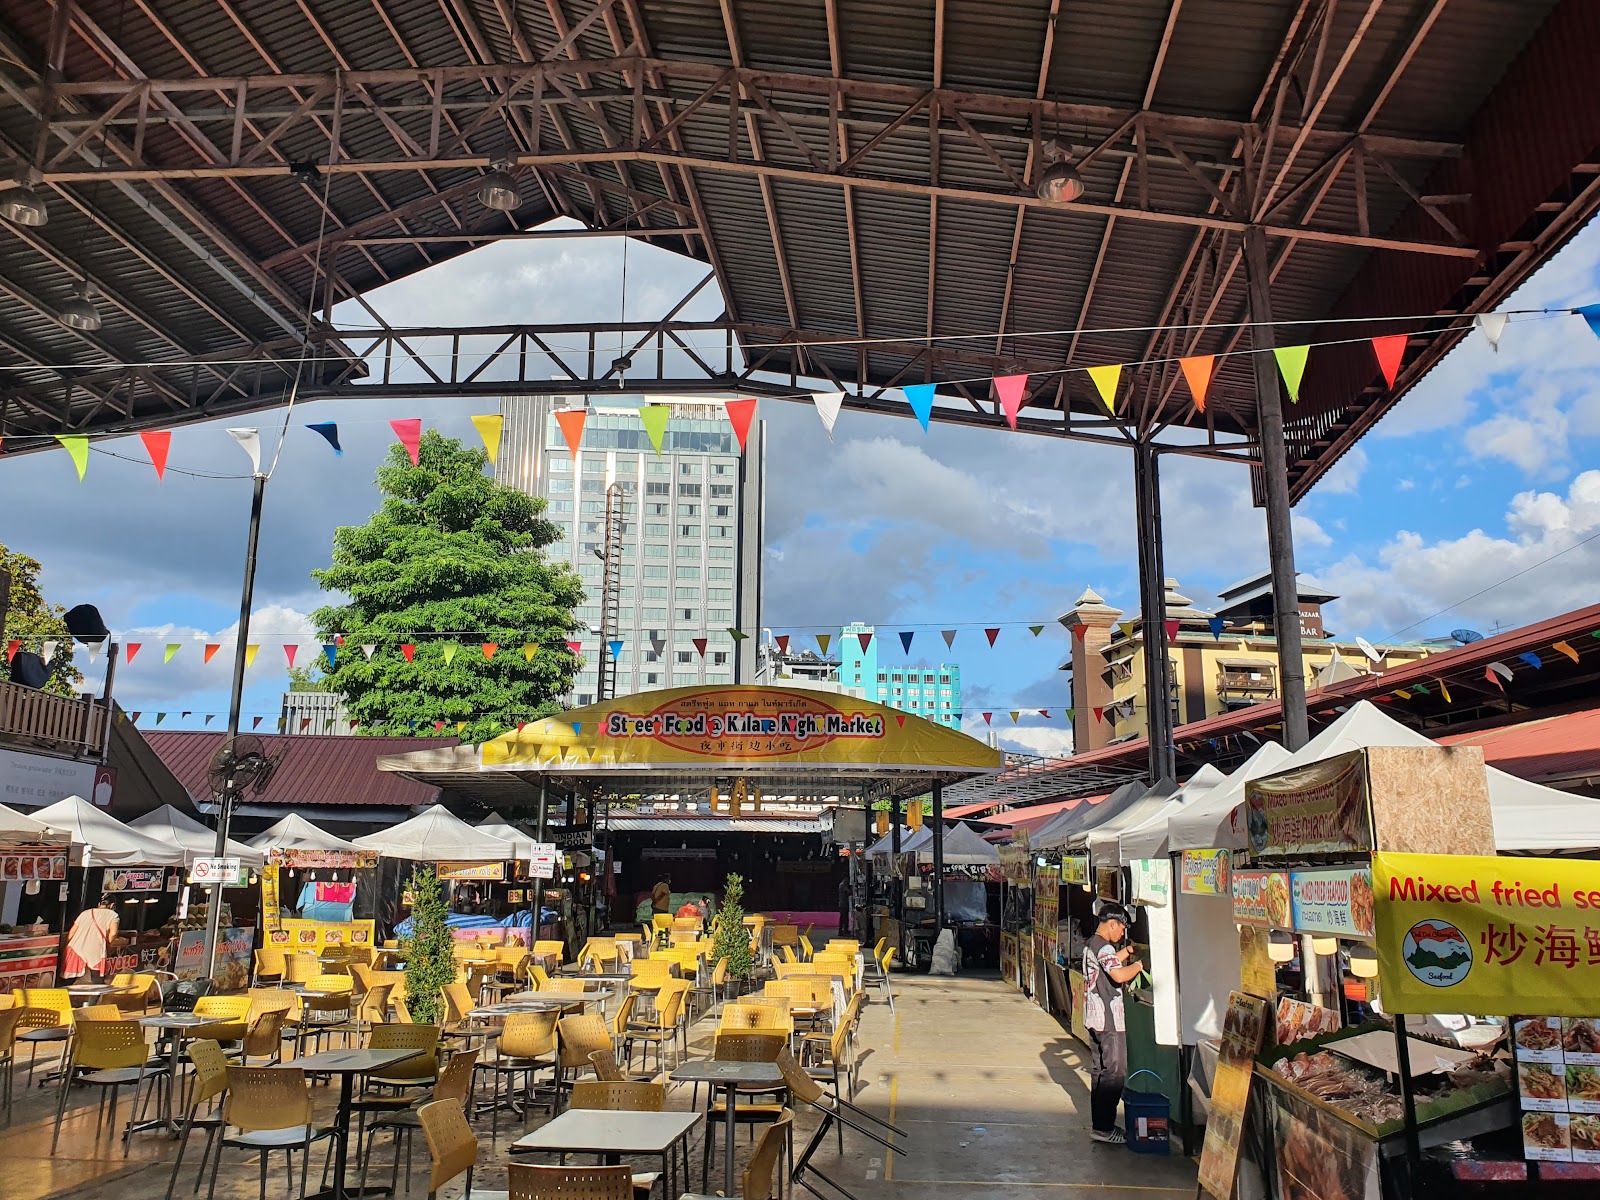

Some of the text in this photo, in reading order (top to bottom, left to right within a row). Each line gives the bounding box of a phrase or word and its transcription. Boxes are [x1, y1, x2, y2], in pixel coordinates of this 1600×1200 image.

[1300, 626, 1318, 635] BAR
[610, 715, 660, 733] Stee
[665, 715, 704, 733] Food
[727, 715, 776, 733] Klae
[781, 715, 823, 737] Ngh
[827, 715, 881, 734] Market
[563, 838, 585, 846] OOD
[217, 863, 237, 871] Smoking
[970, 863, 991, 874] RIBS
[1389, 876, 1481, 905] Mixed
[1490, 880, 1562, 909] fried
[1428, 971, 1454, 982] Seafood
